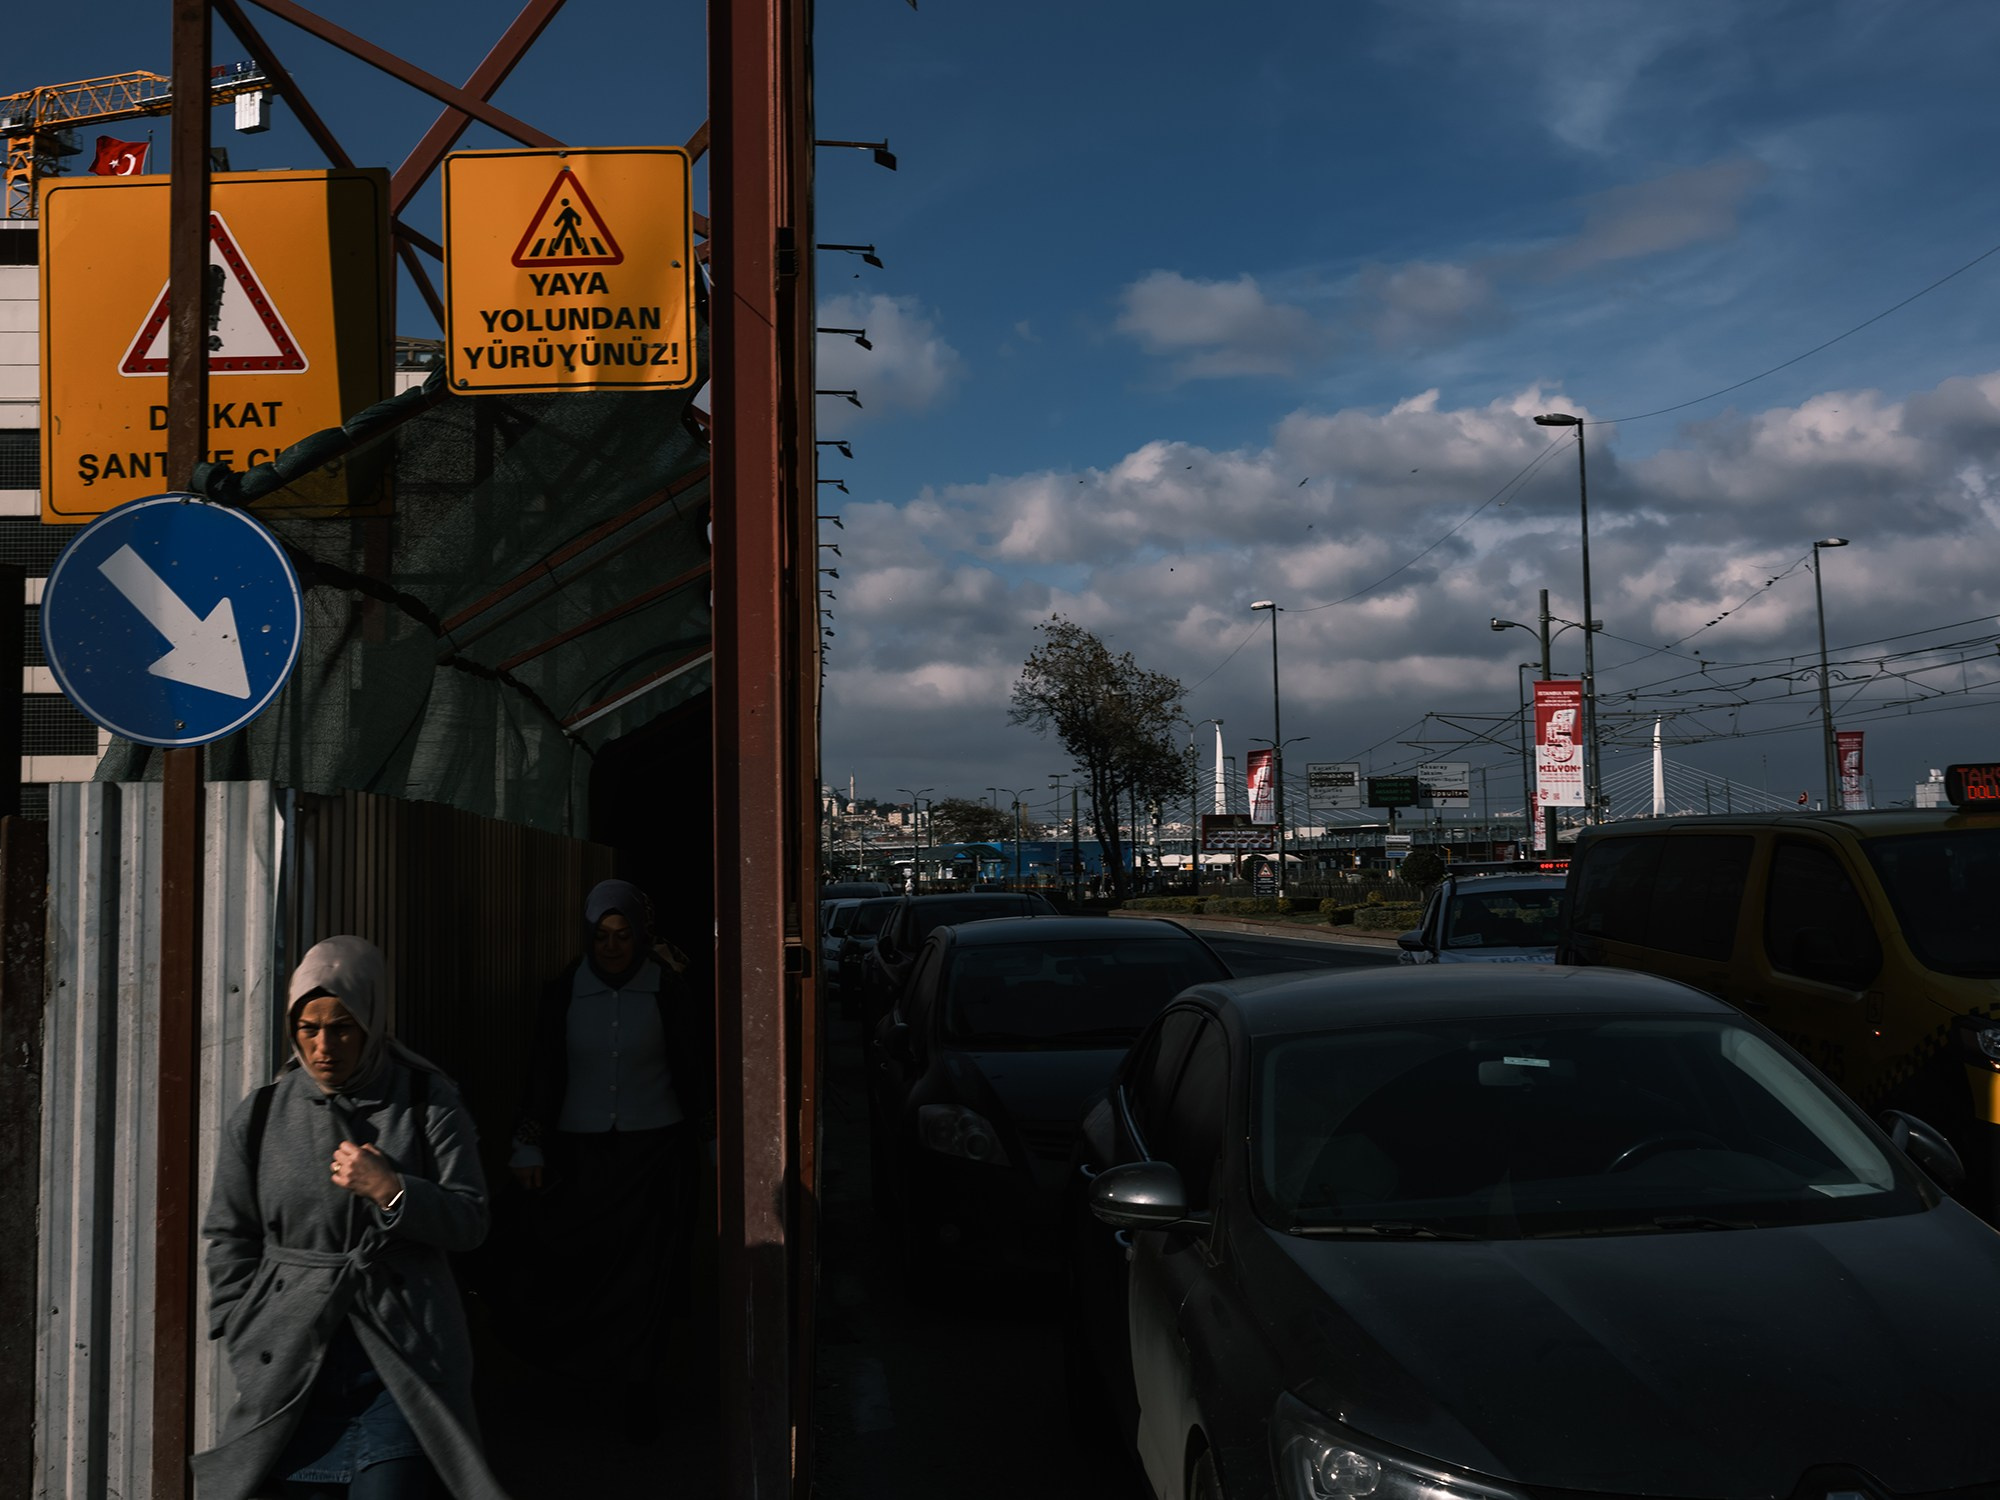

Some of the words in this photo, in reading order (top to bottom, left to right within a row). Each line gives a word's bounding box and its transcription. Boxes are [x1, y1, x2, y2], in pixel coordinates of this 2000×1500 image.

[528, 272, 609, 296] YAYA
[480, 307, 660, 333] YOLUNDAN
[463, 336, 678, 369] YÜRÜYÜNÜZ!
[150, 402, 282, 430] DKAT
[78, 450, 234, 486] ŞANTE
